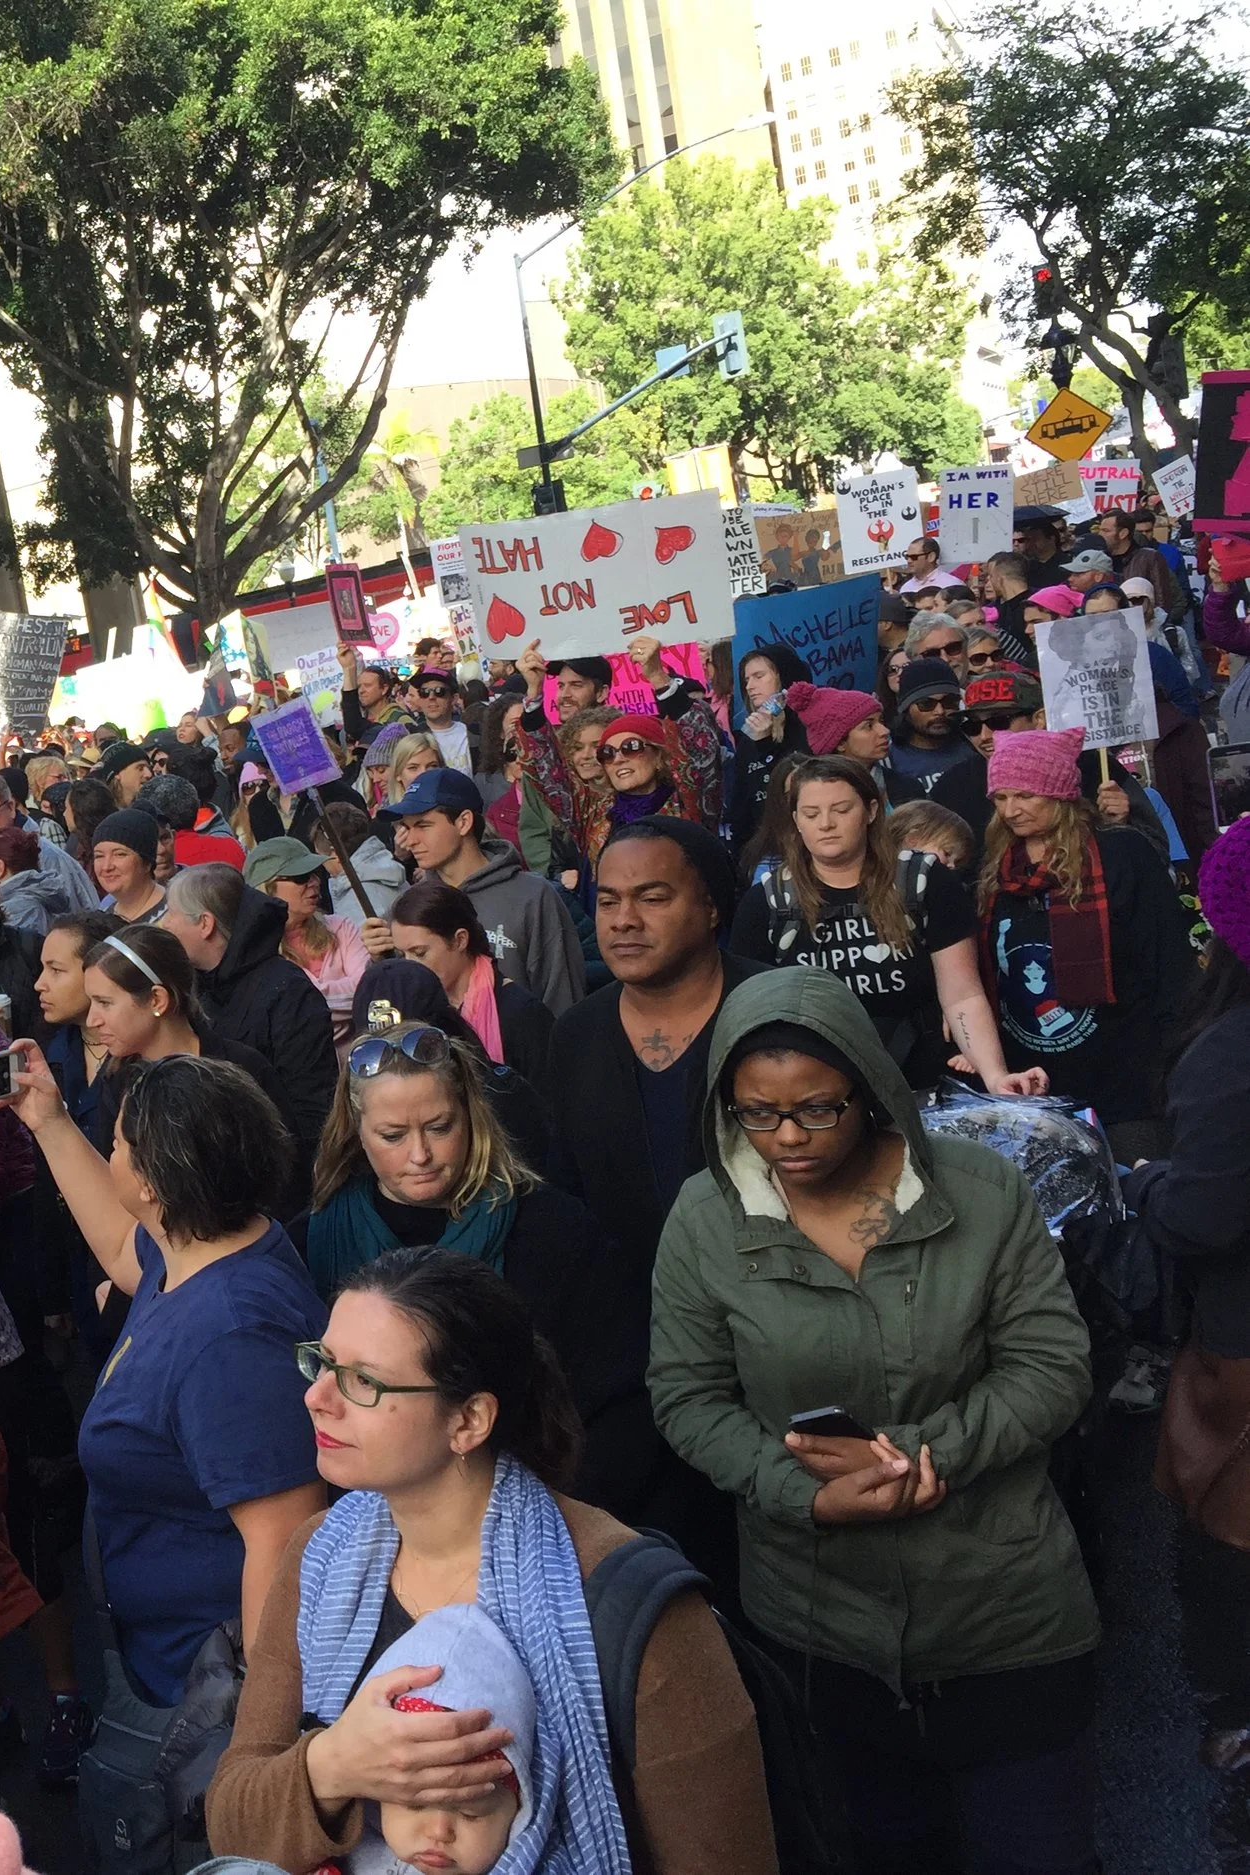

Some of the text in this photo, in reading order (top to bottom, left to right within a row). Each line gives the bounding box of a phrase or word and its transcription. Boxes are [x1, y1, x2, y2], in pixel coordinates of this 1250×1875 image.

[871, 479, 878, 487] A
[976, 469, 1008, 480] WITH
[852, 481, 904, 498] WOMAN'S
[859, 492, 891, 505] PLACE
[859, 500, 893, 512] IS IN
[949, 492, 999, 509] HER
[867, 509, 888, 519] THE
[472, 536, 544, 574] HATE
[851, 550, 908, 567] RESISTANC
[539, 578, 597, 616] NOT
[619, 590, 698, 635] LOVE
[371, 625, 391, 636] OVE
[806, 636, 866, 677] BAMA
[1065, 668, 1129, 687] WOMAN'S
[1080, 680, 1118, 695] PLACE
[614, 689, 645, 705] WITH
[1082, 692, 1120, 711] IS IN
[1084, 708, 1123, 729] THE
[1085, 724, 1141, 742] SISTANCE
[844, 969, 906, 995] IRLS
